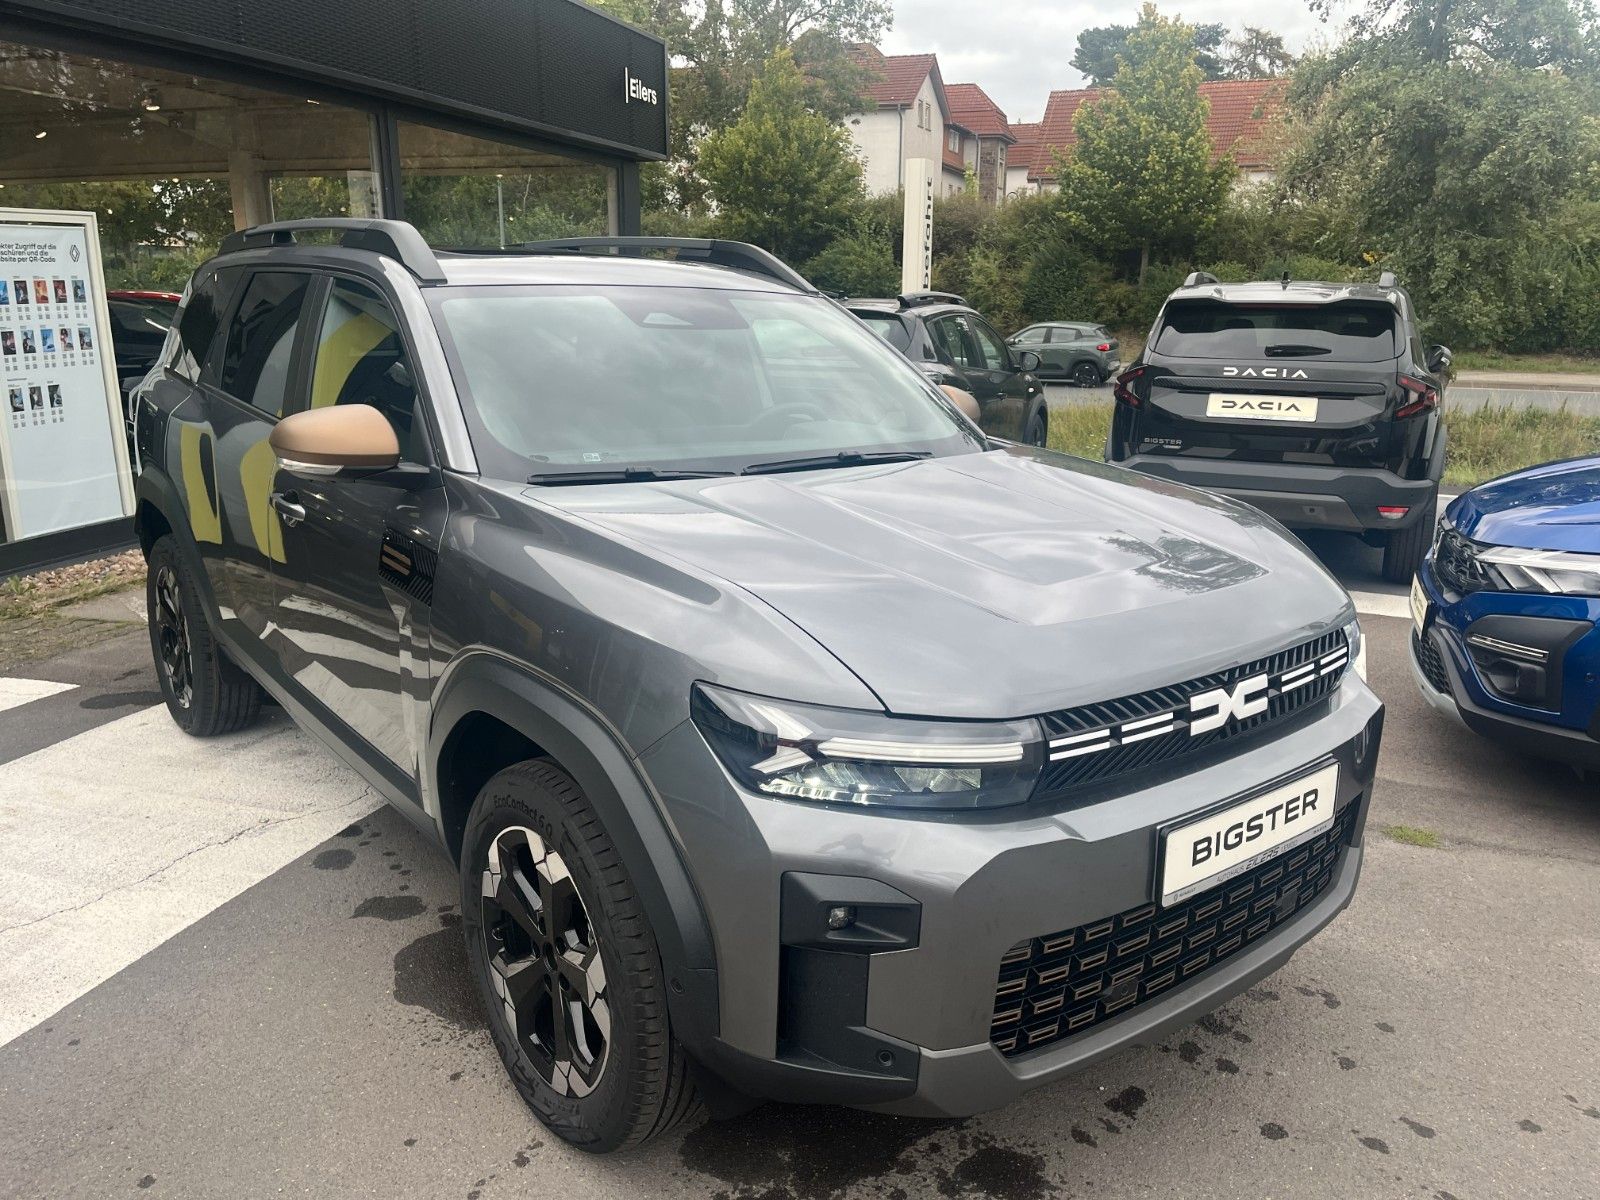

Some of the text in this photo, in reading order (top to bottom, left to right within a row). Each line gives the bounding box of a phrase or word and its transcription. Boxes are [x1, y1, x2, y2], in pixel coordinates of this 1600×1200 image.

[629, 77, 657, 105] Eilers
[922, 177, 932, 289] befahrt
[15, 243, 36, 251] Zugriff
[1223, 367, 1309, 379] DACIA
[1221, 400, 1301, 412] DACIA
[1144, 437, 1182, 445] BIGSTER
[493, 794, 538, 822] EcoContact
[538, 813, 546, 828] 6
[1191, 788, 1319, 867] BIGSTER
[1245, 847, 1280, 870] EILERS
